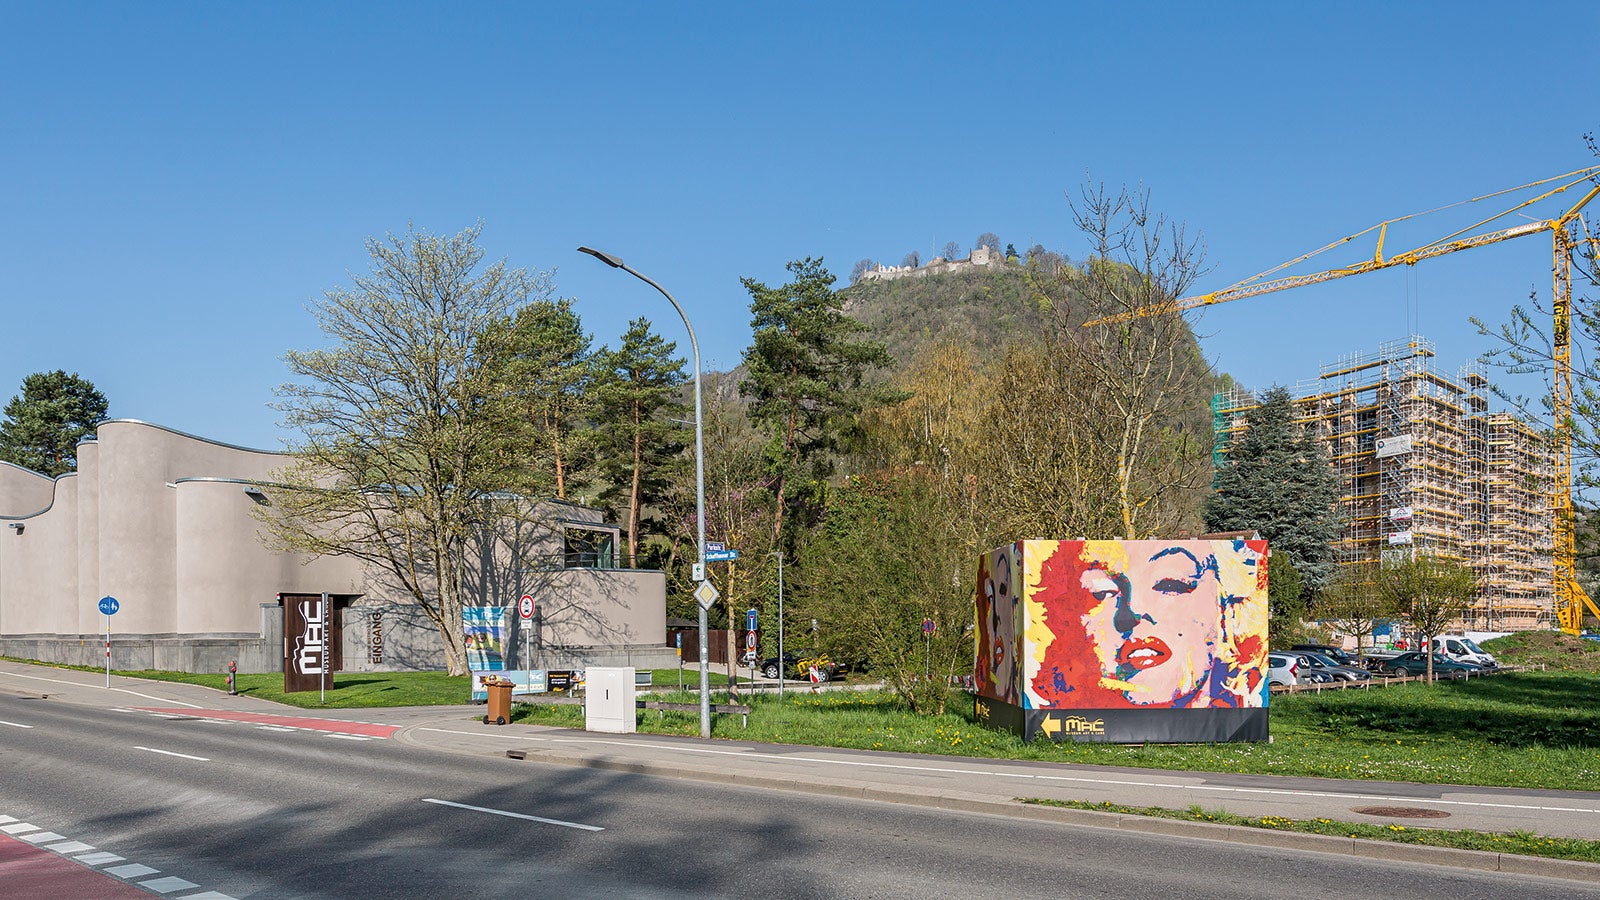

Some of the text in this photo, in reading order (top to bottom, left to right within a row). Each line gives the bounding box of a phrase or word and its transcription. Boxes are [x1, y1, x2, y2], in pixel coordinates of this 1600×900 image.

[298, 601, 322, 675] MAC
[372, 612, 382, 664] EINGANG
[1065, 718, 1105, 732] MAC
